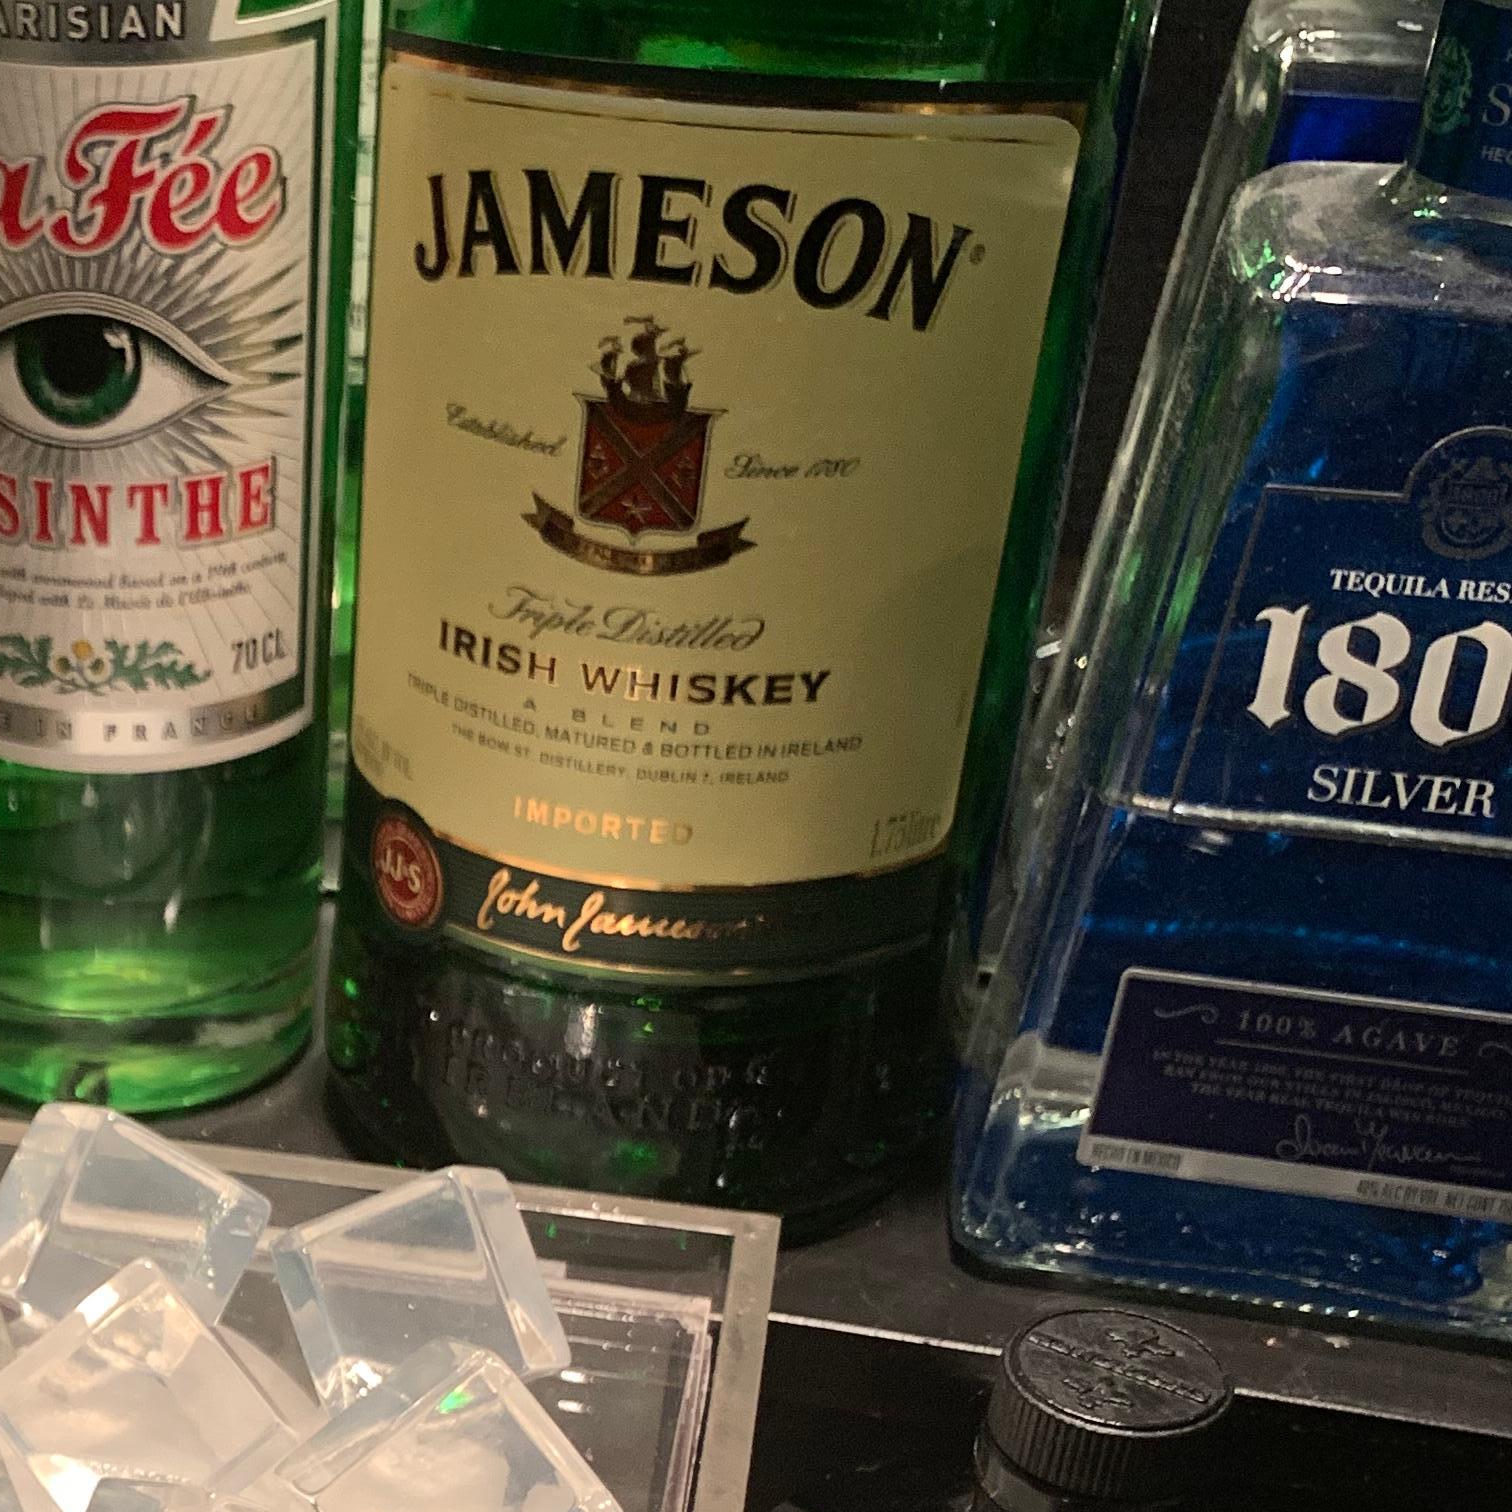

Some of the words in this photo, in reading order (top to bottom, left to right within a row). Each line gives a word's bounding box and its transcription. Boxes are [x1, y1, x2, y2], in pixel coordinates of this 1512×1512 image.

[44, 95, 287, 256] Fée
[414, 168, 976, 333] JAMESON
[1329, 567, 1452, 600] TEQUILA
[489, 585, 594, 641] Triple
[596, 605, 766, 653] Distilled
[438, 616, 559, 687] IRISH
[580, 660, 832, 708] WHISKEY
[544, 724, 637, 754] MATURED
[659, 742, 753, 761] BOTTLED
[756, 742, 778, 759] IN
[780, 733, 865, 759] IRELAND
[570, 708, 711, 737] BLEND
[1306, 763, 1496, 819] SILVER
[512, 795, 695, 846] IMPORTED
[476, 866, 569, 932] John
[1332, 1023, 1461, 1058] AGAVE
